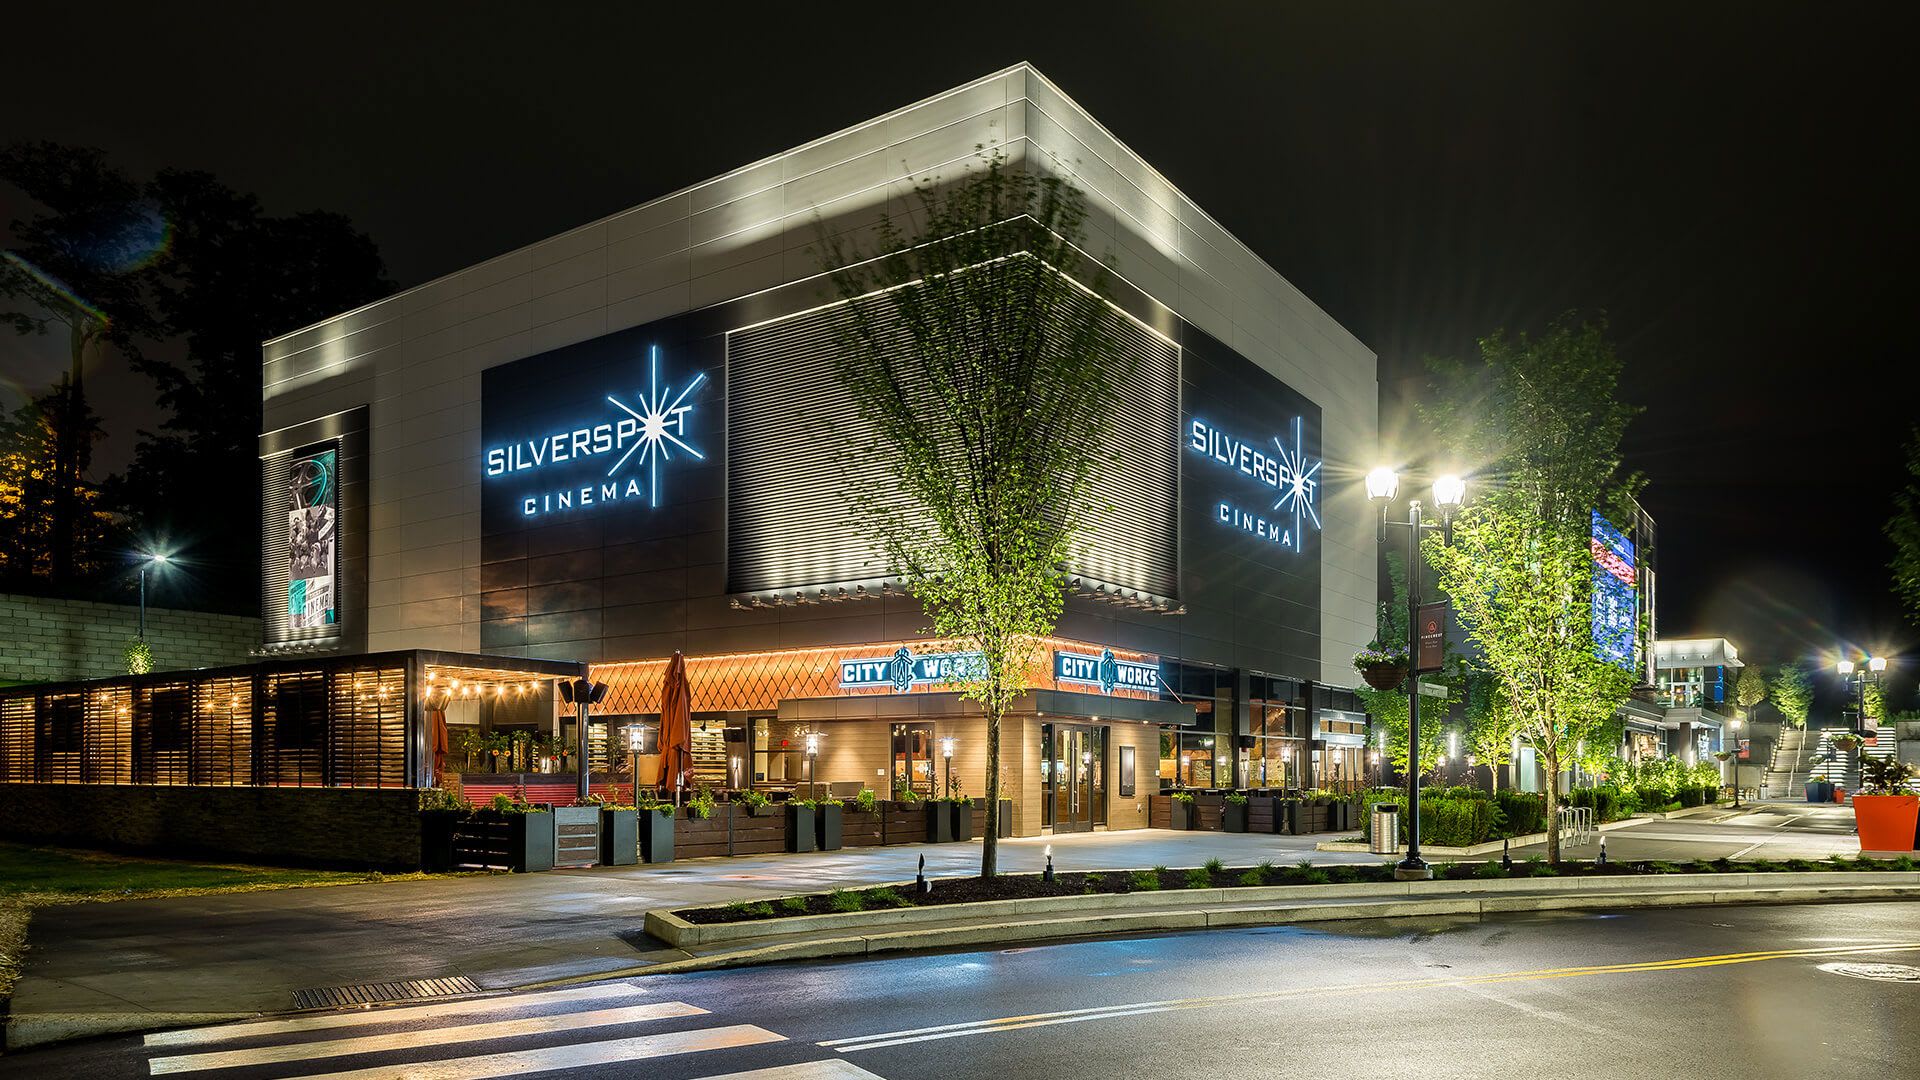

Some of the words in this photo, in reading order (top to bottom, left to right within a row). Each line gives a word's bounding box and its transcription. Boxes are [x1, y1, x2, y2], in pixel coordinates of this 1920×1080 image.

[524, 480, 641, 515] CINEMA
[1220, 504, 1292, 547] CINEMA
[843, 662, 888, 682] CITY
[922, 658, 989, 679] WOR
[1062, 657, 1095, 679] CITY
[1117, 665, 1157, 686] WORKS
